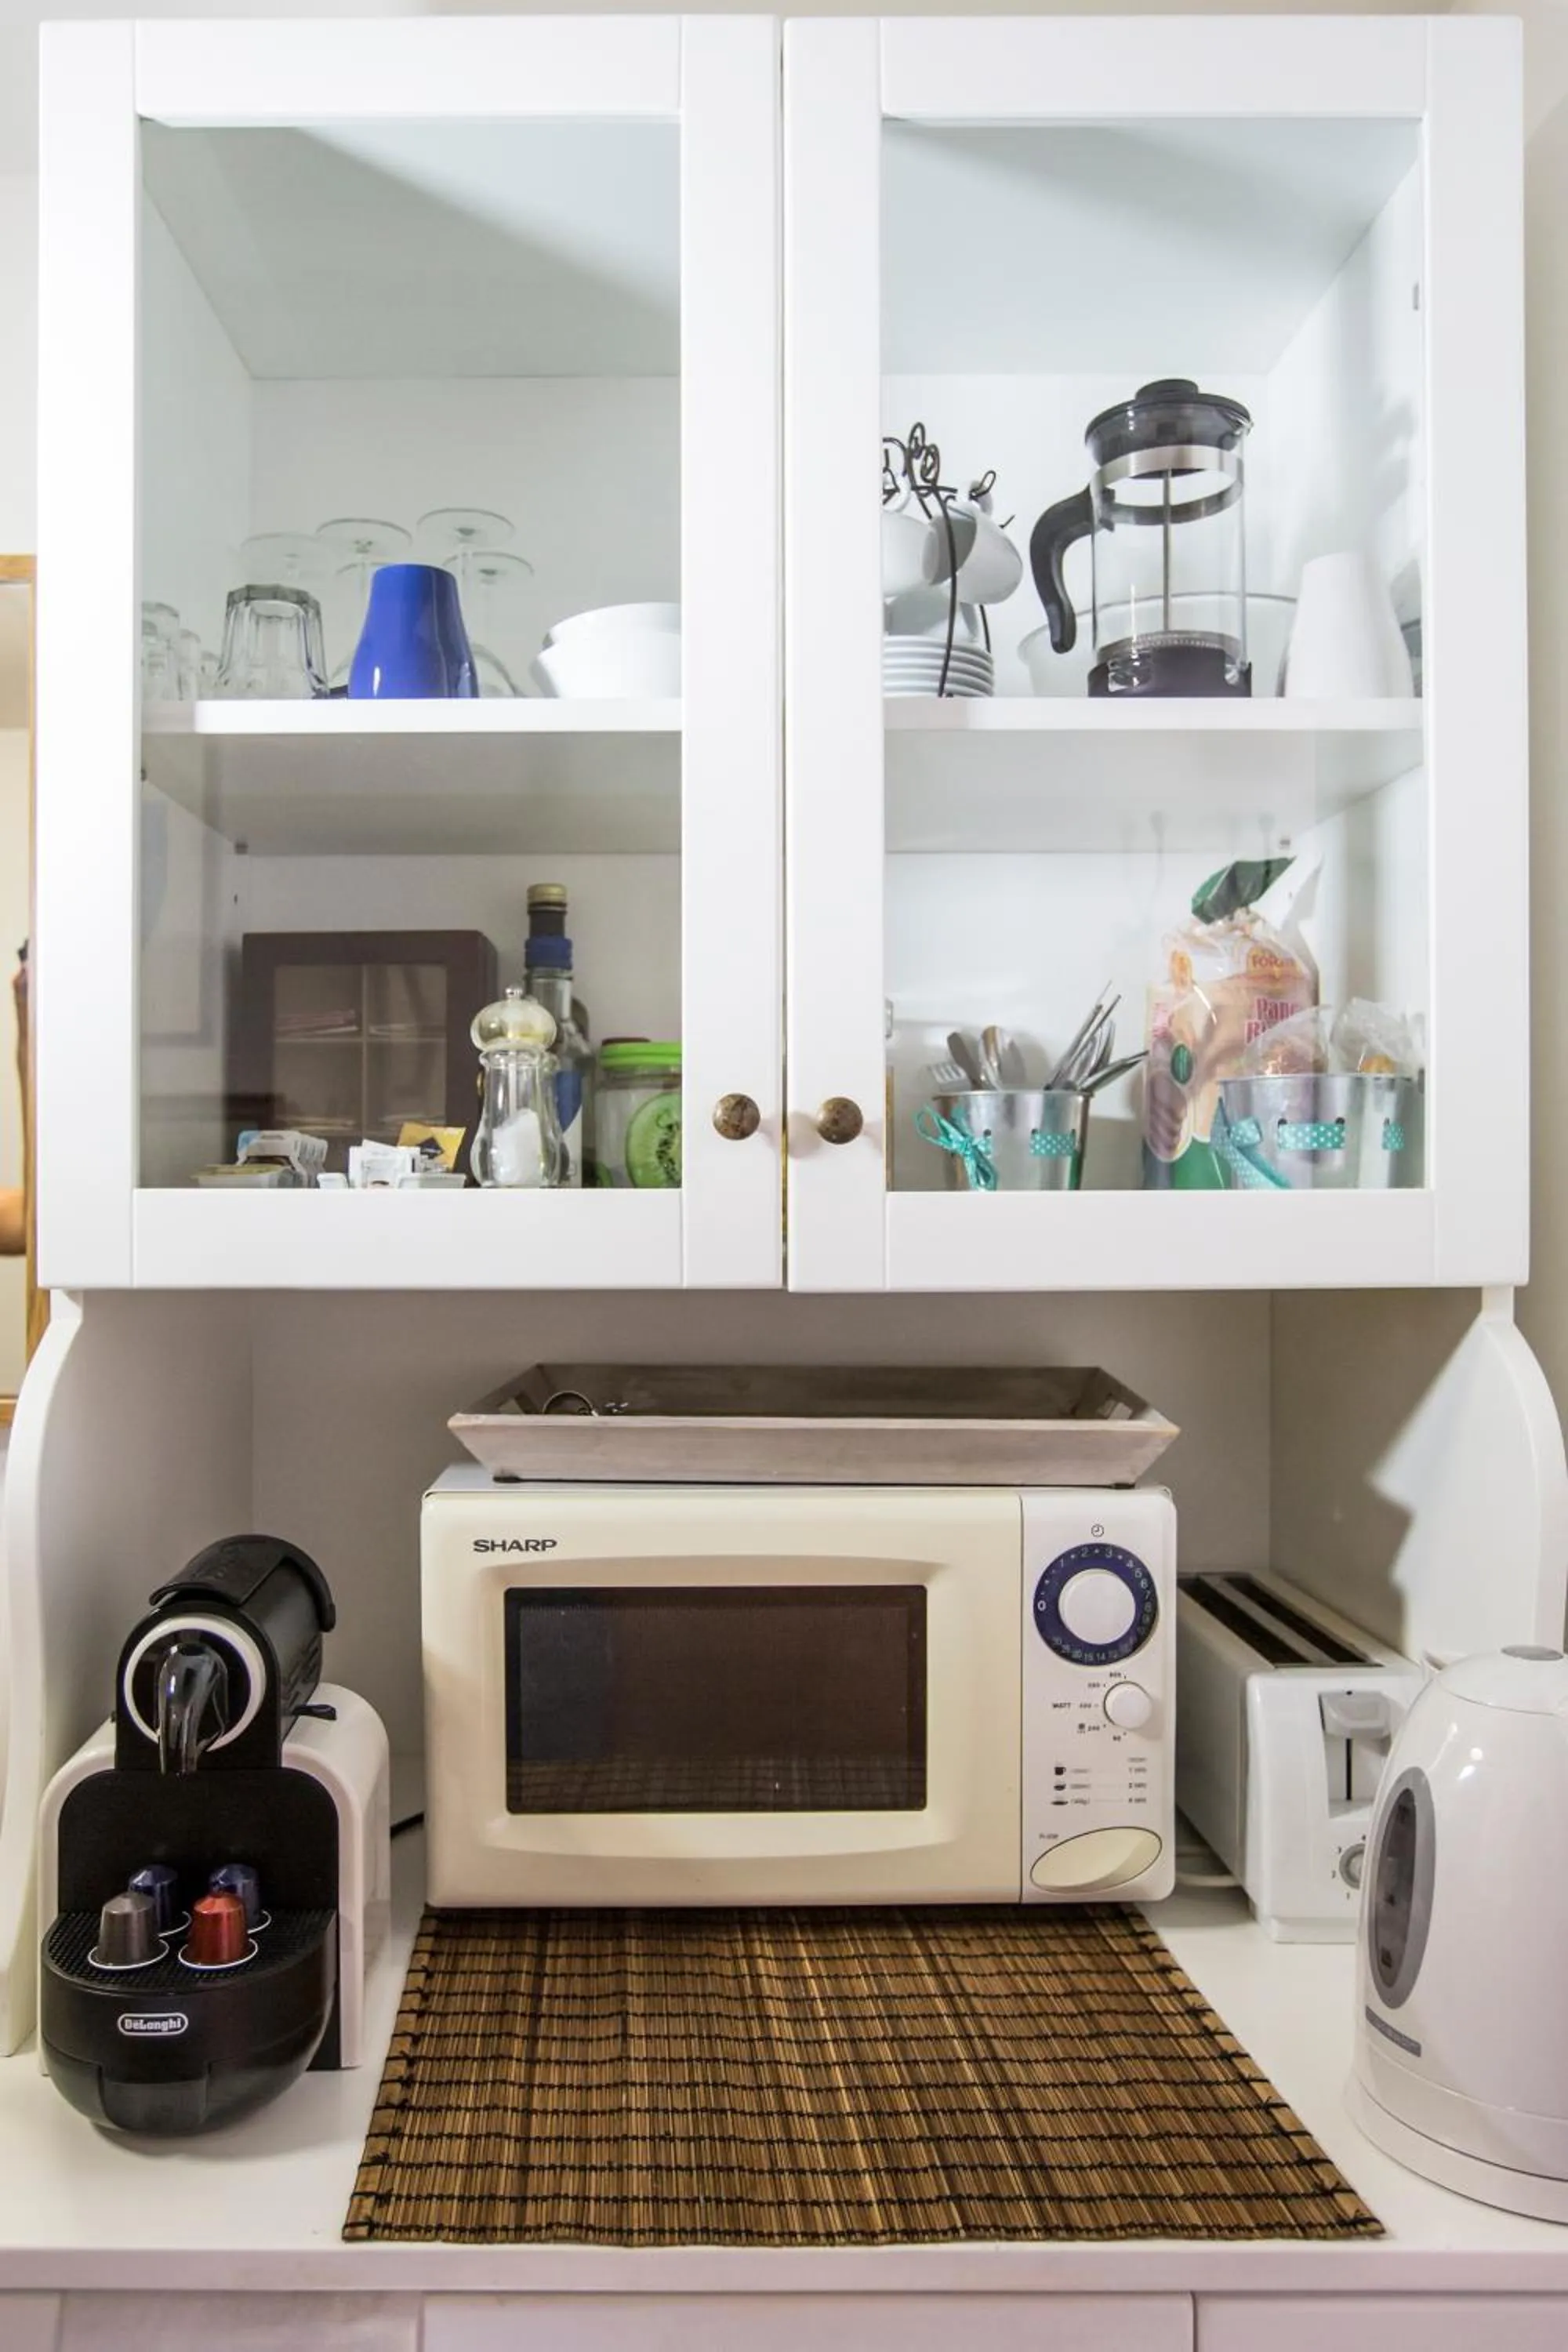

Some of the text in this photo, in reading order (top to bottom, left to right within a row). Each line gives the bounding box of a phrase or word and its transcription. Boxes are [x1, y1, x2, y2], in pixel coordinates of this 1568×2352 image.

[473, 1539, 557, 1552] SHARP
[1081, 1547, 1089, 1558] 2
[1105, 1548, 1113, 1559] 3
[1126, 1559, 1134, 1568] 4
[1141, 1578, 1149, 1589] 6
[1037, 1599, 1047, 1612] 0
